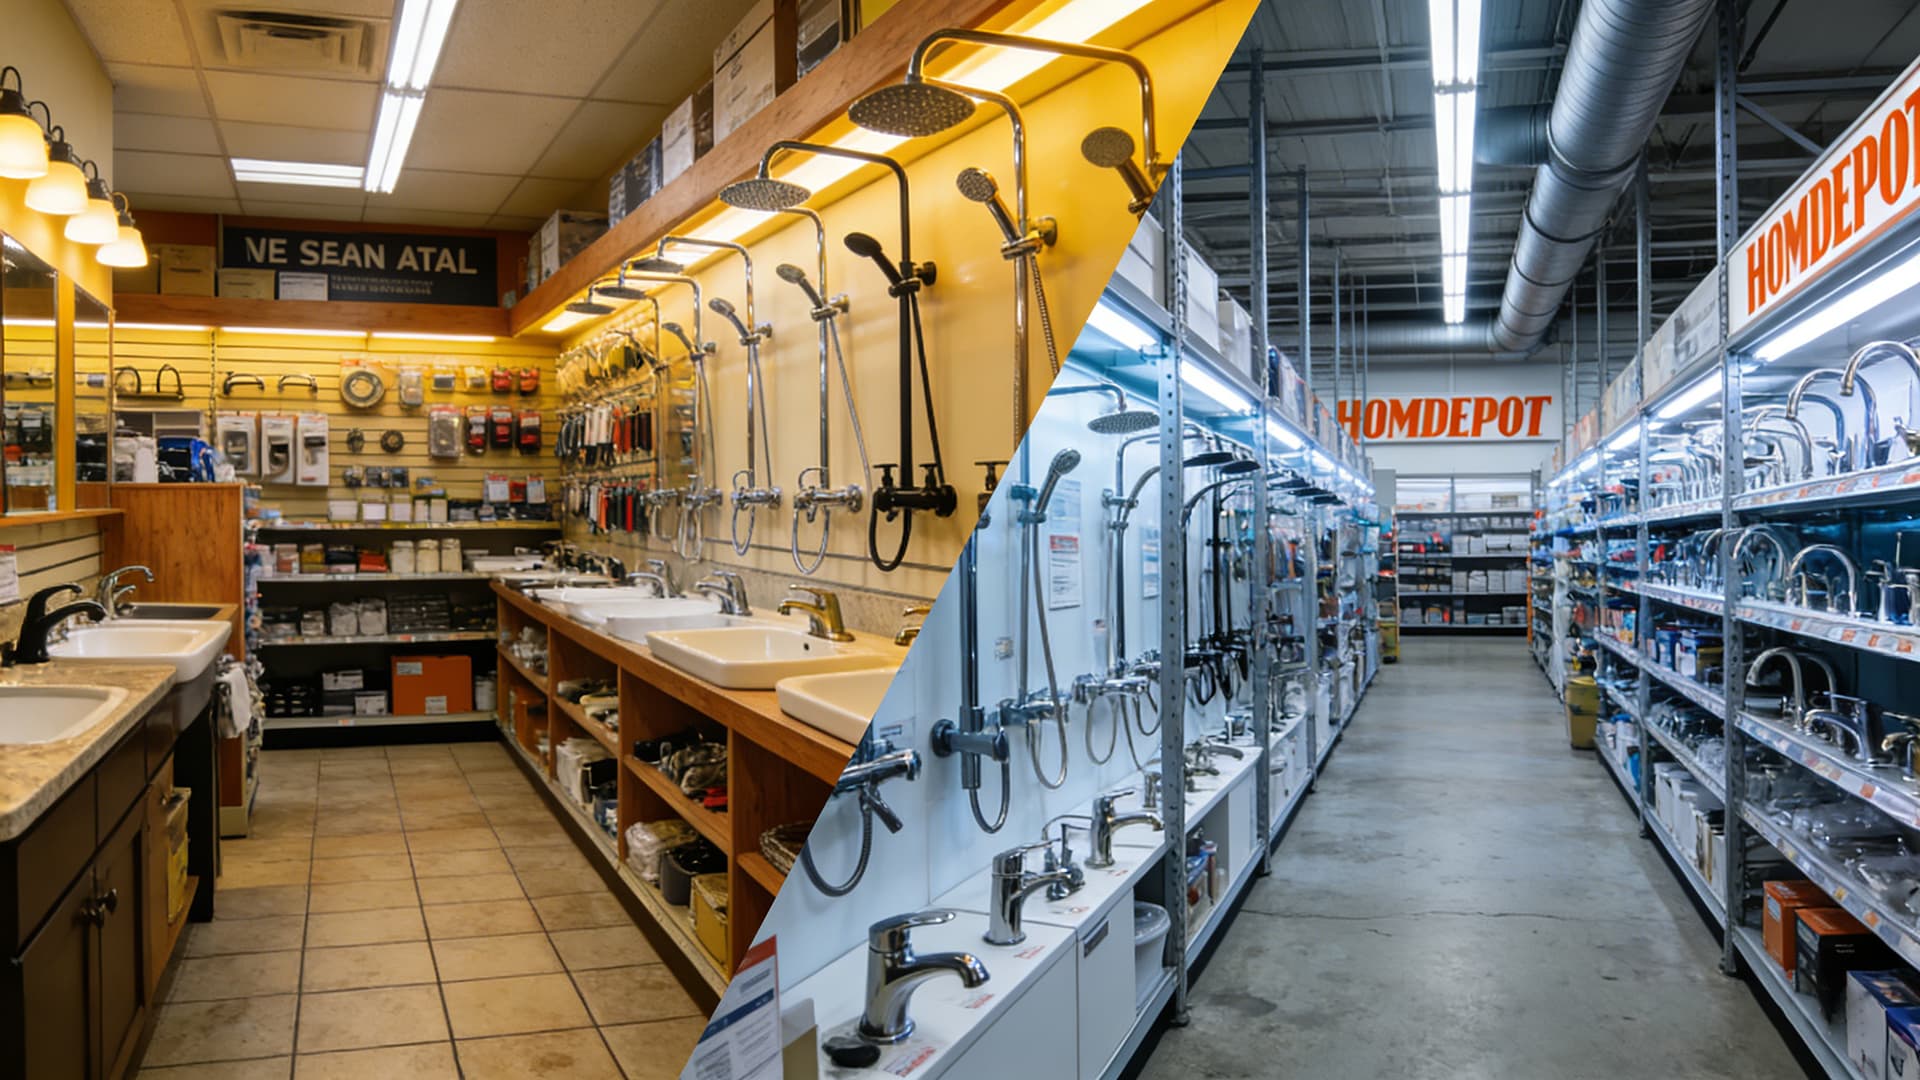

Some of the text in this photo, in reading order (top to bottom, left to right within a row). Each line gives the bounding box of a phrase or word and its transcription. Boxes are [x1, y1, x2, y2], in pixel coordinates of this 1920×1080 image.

[299, 239, 386, 270] SEAN
[397, 245, 479, 275] ATAL
[1337, 395, 1553, 443] HOMDEPOT
